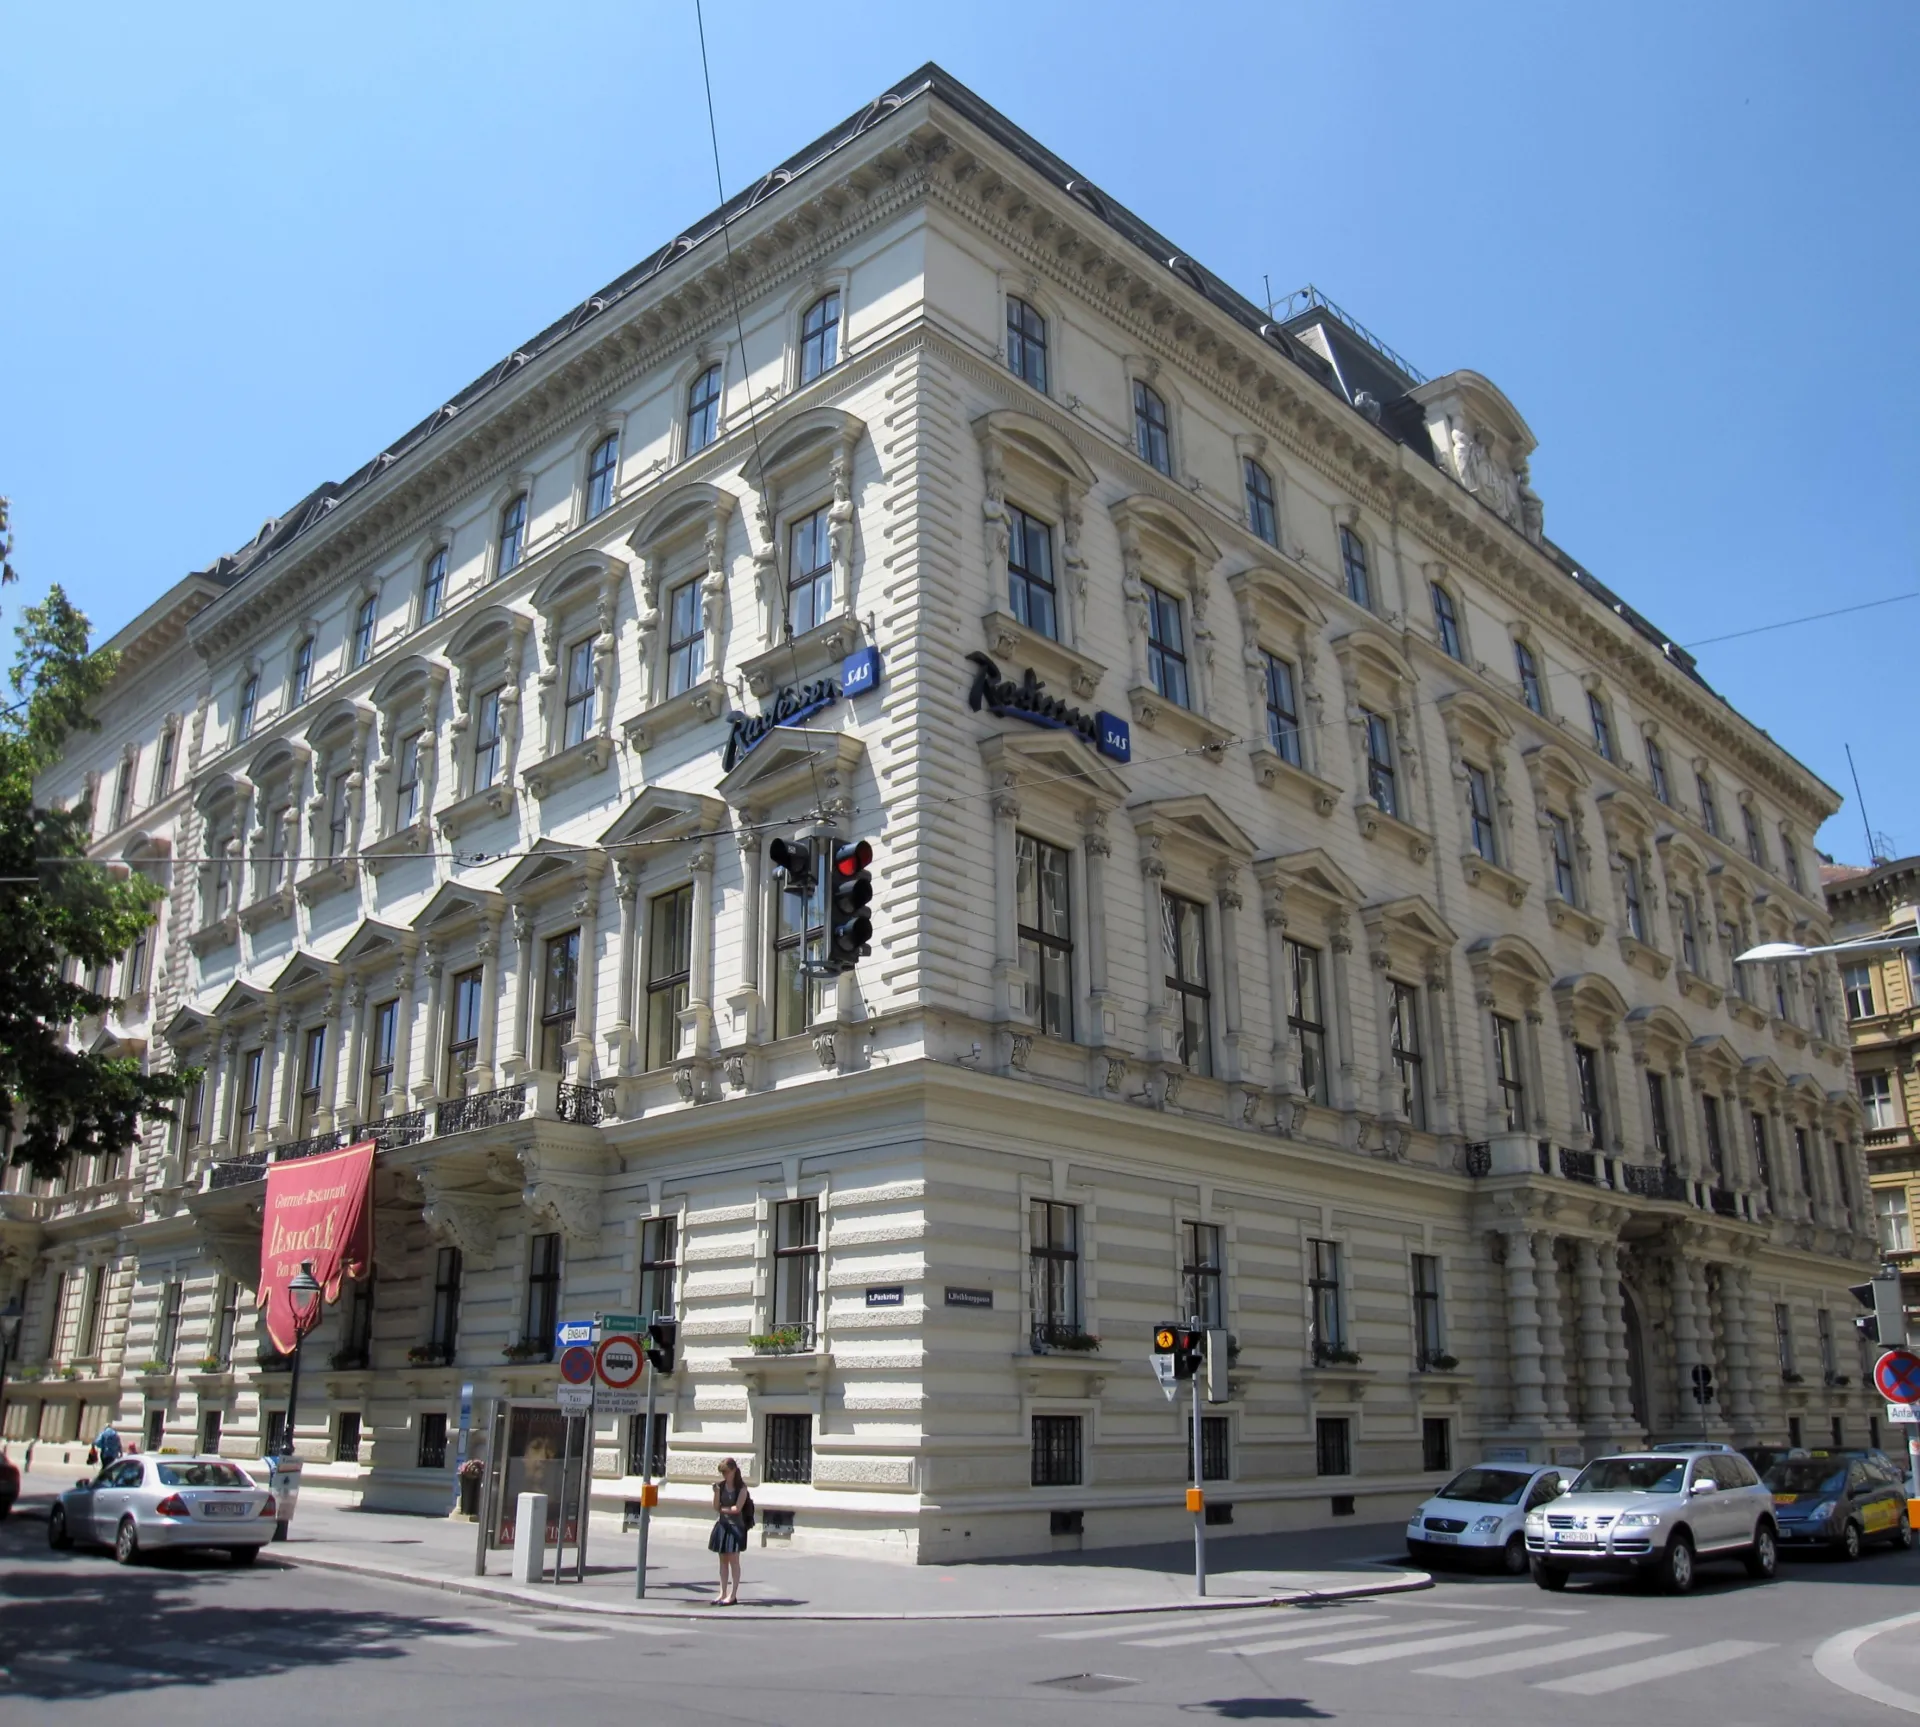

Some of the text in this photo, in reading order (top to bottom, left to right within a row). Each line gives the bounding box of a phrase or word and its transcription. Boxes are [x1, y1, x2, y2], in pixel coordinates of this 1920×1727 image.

[844, 662, 871, 687] SAS
[1105, 730, 1129, 751] SAS
[567, 1328, 588, 1340] EINBAHN
